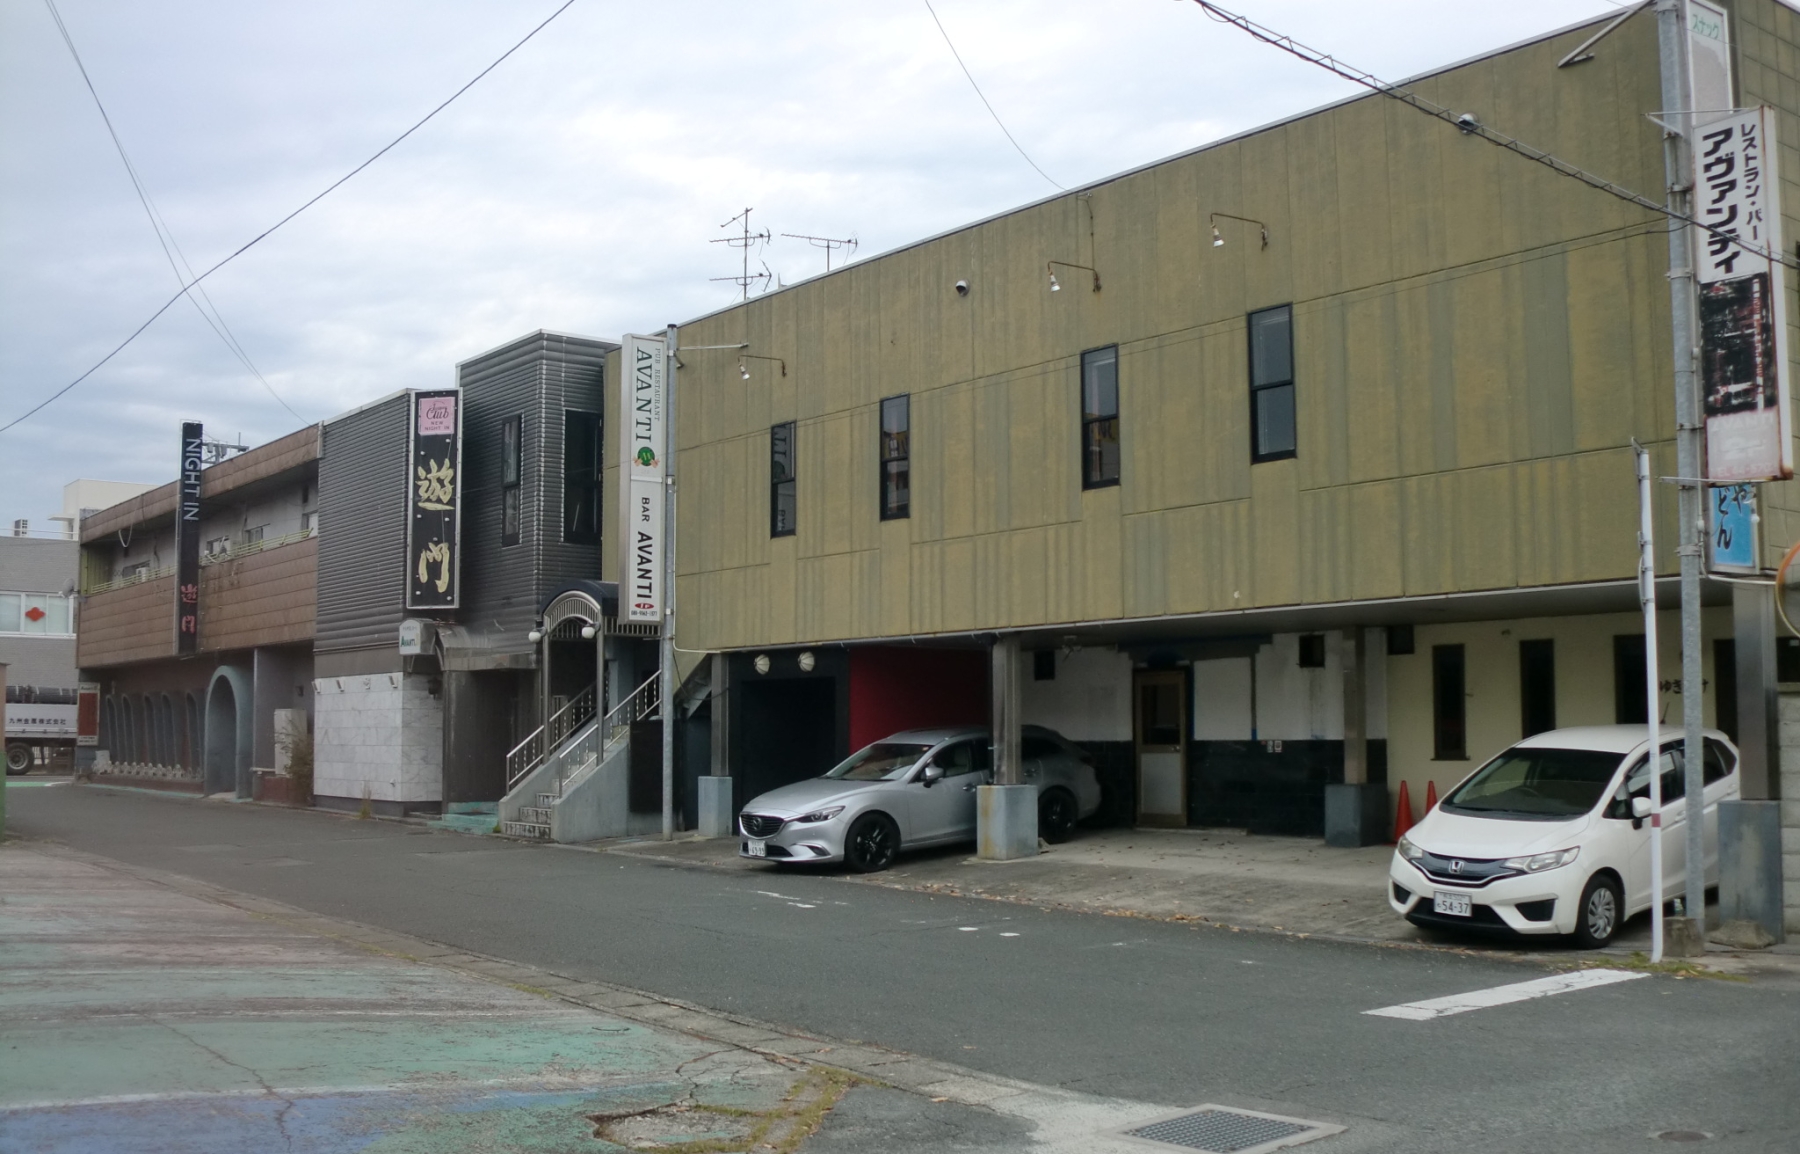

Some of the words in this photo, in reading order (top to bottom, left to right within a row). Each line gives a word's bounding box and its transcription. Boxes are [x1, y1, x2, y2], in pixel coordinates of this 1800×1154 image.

[1692, 13, 1719, 39] スナック
[1702, 126, 1741, 275] アヴァンティ
[1741, 123, 1763, 241] レストラン・バー
[426, 405, 450, 420] Club
[636, 346, 653, 443] AVANTI
[184, 438, 202, 498] NIGHT
[183, 502, 200, 521] IN
[641, 496, 650, 523] BAR
[637, 530, 653, 599] AVANTI
[1442, 900, 1469, 914] 54-37
